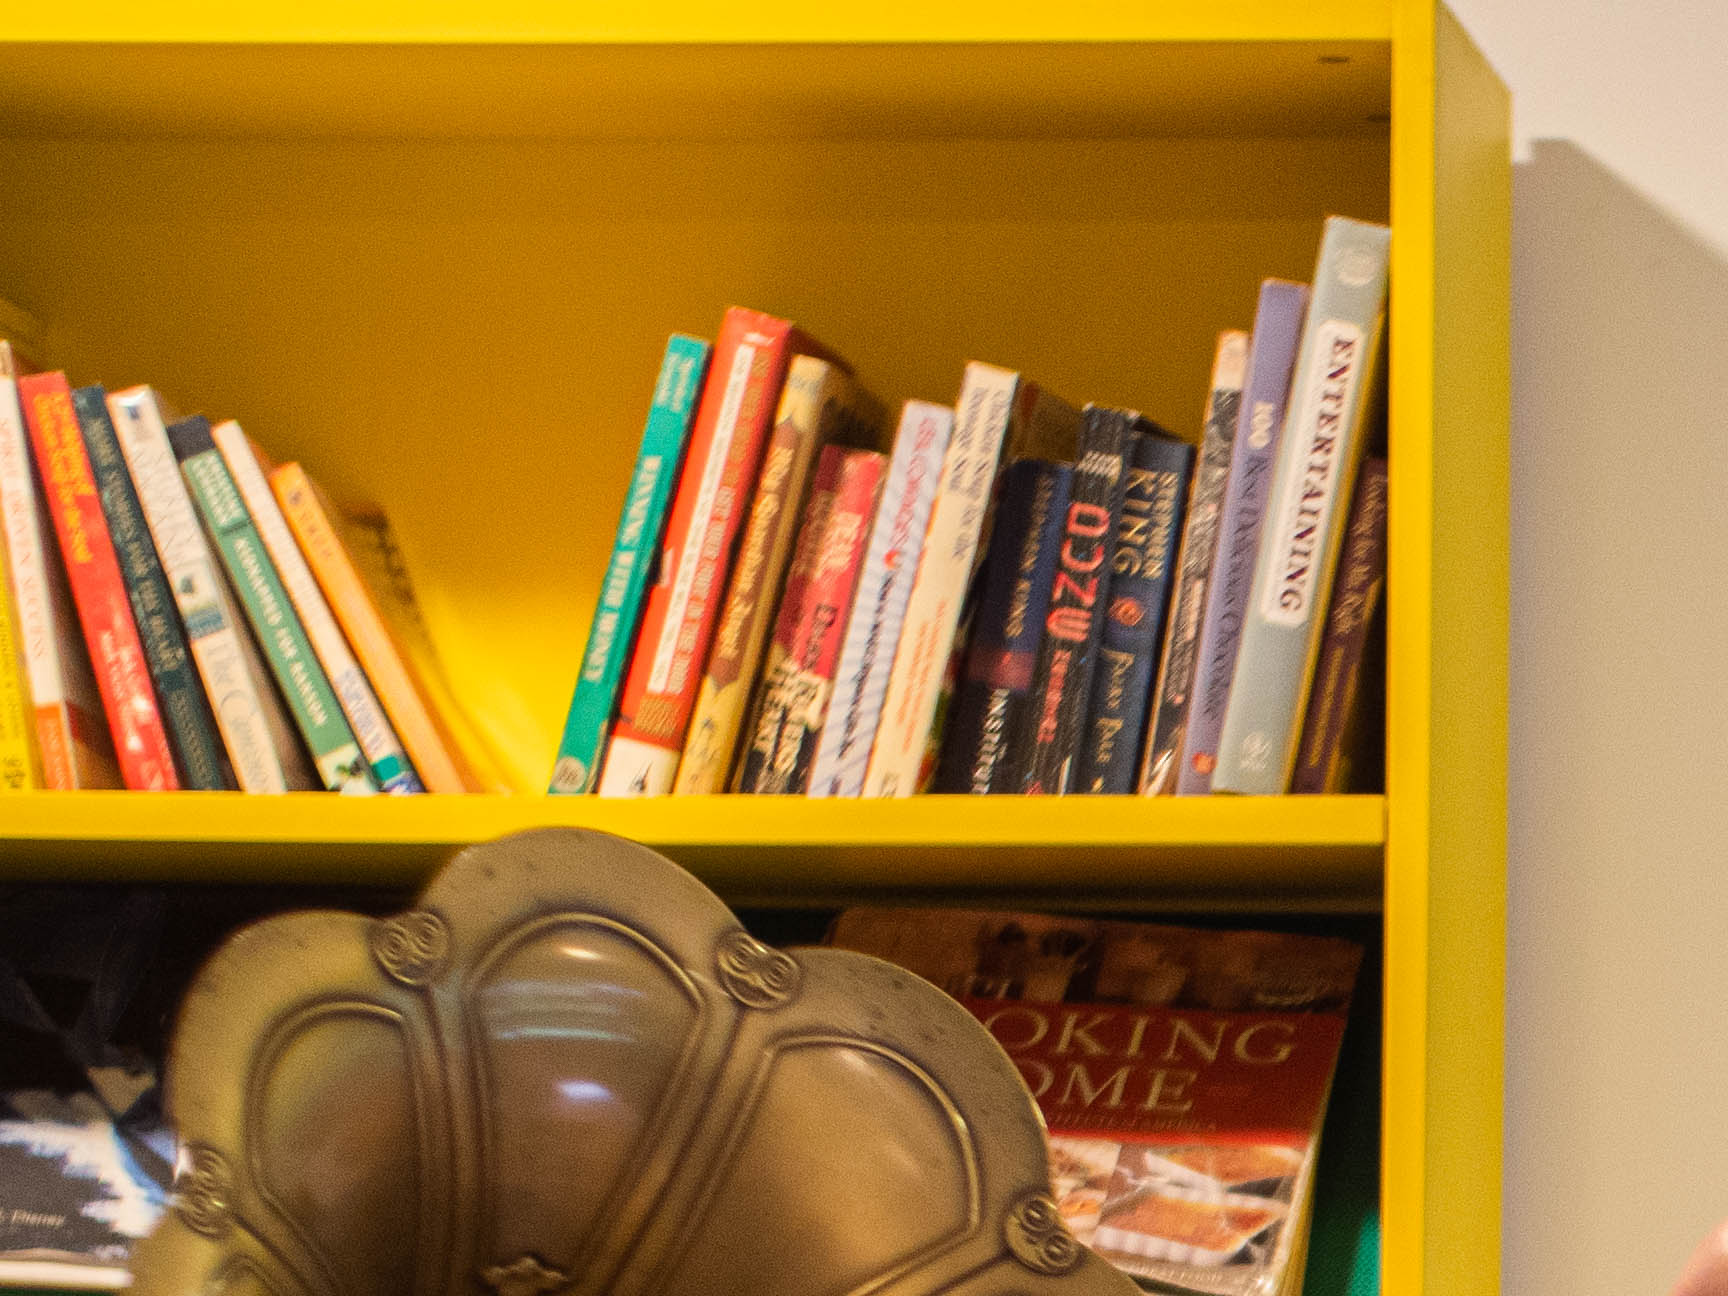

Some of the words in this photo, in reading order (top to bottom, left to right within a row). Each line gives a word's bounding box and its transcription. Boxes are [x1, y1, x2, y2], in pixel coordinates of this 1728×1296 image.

[1245, 399, 1276, 452] 100
[1275, 334, 1358, 614] ENTERTAINING
[1112, 466, 1154, 577] KING
[985, 1006, 1298, 1066] OKING
